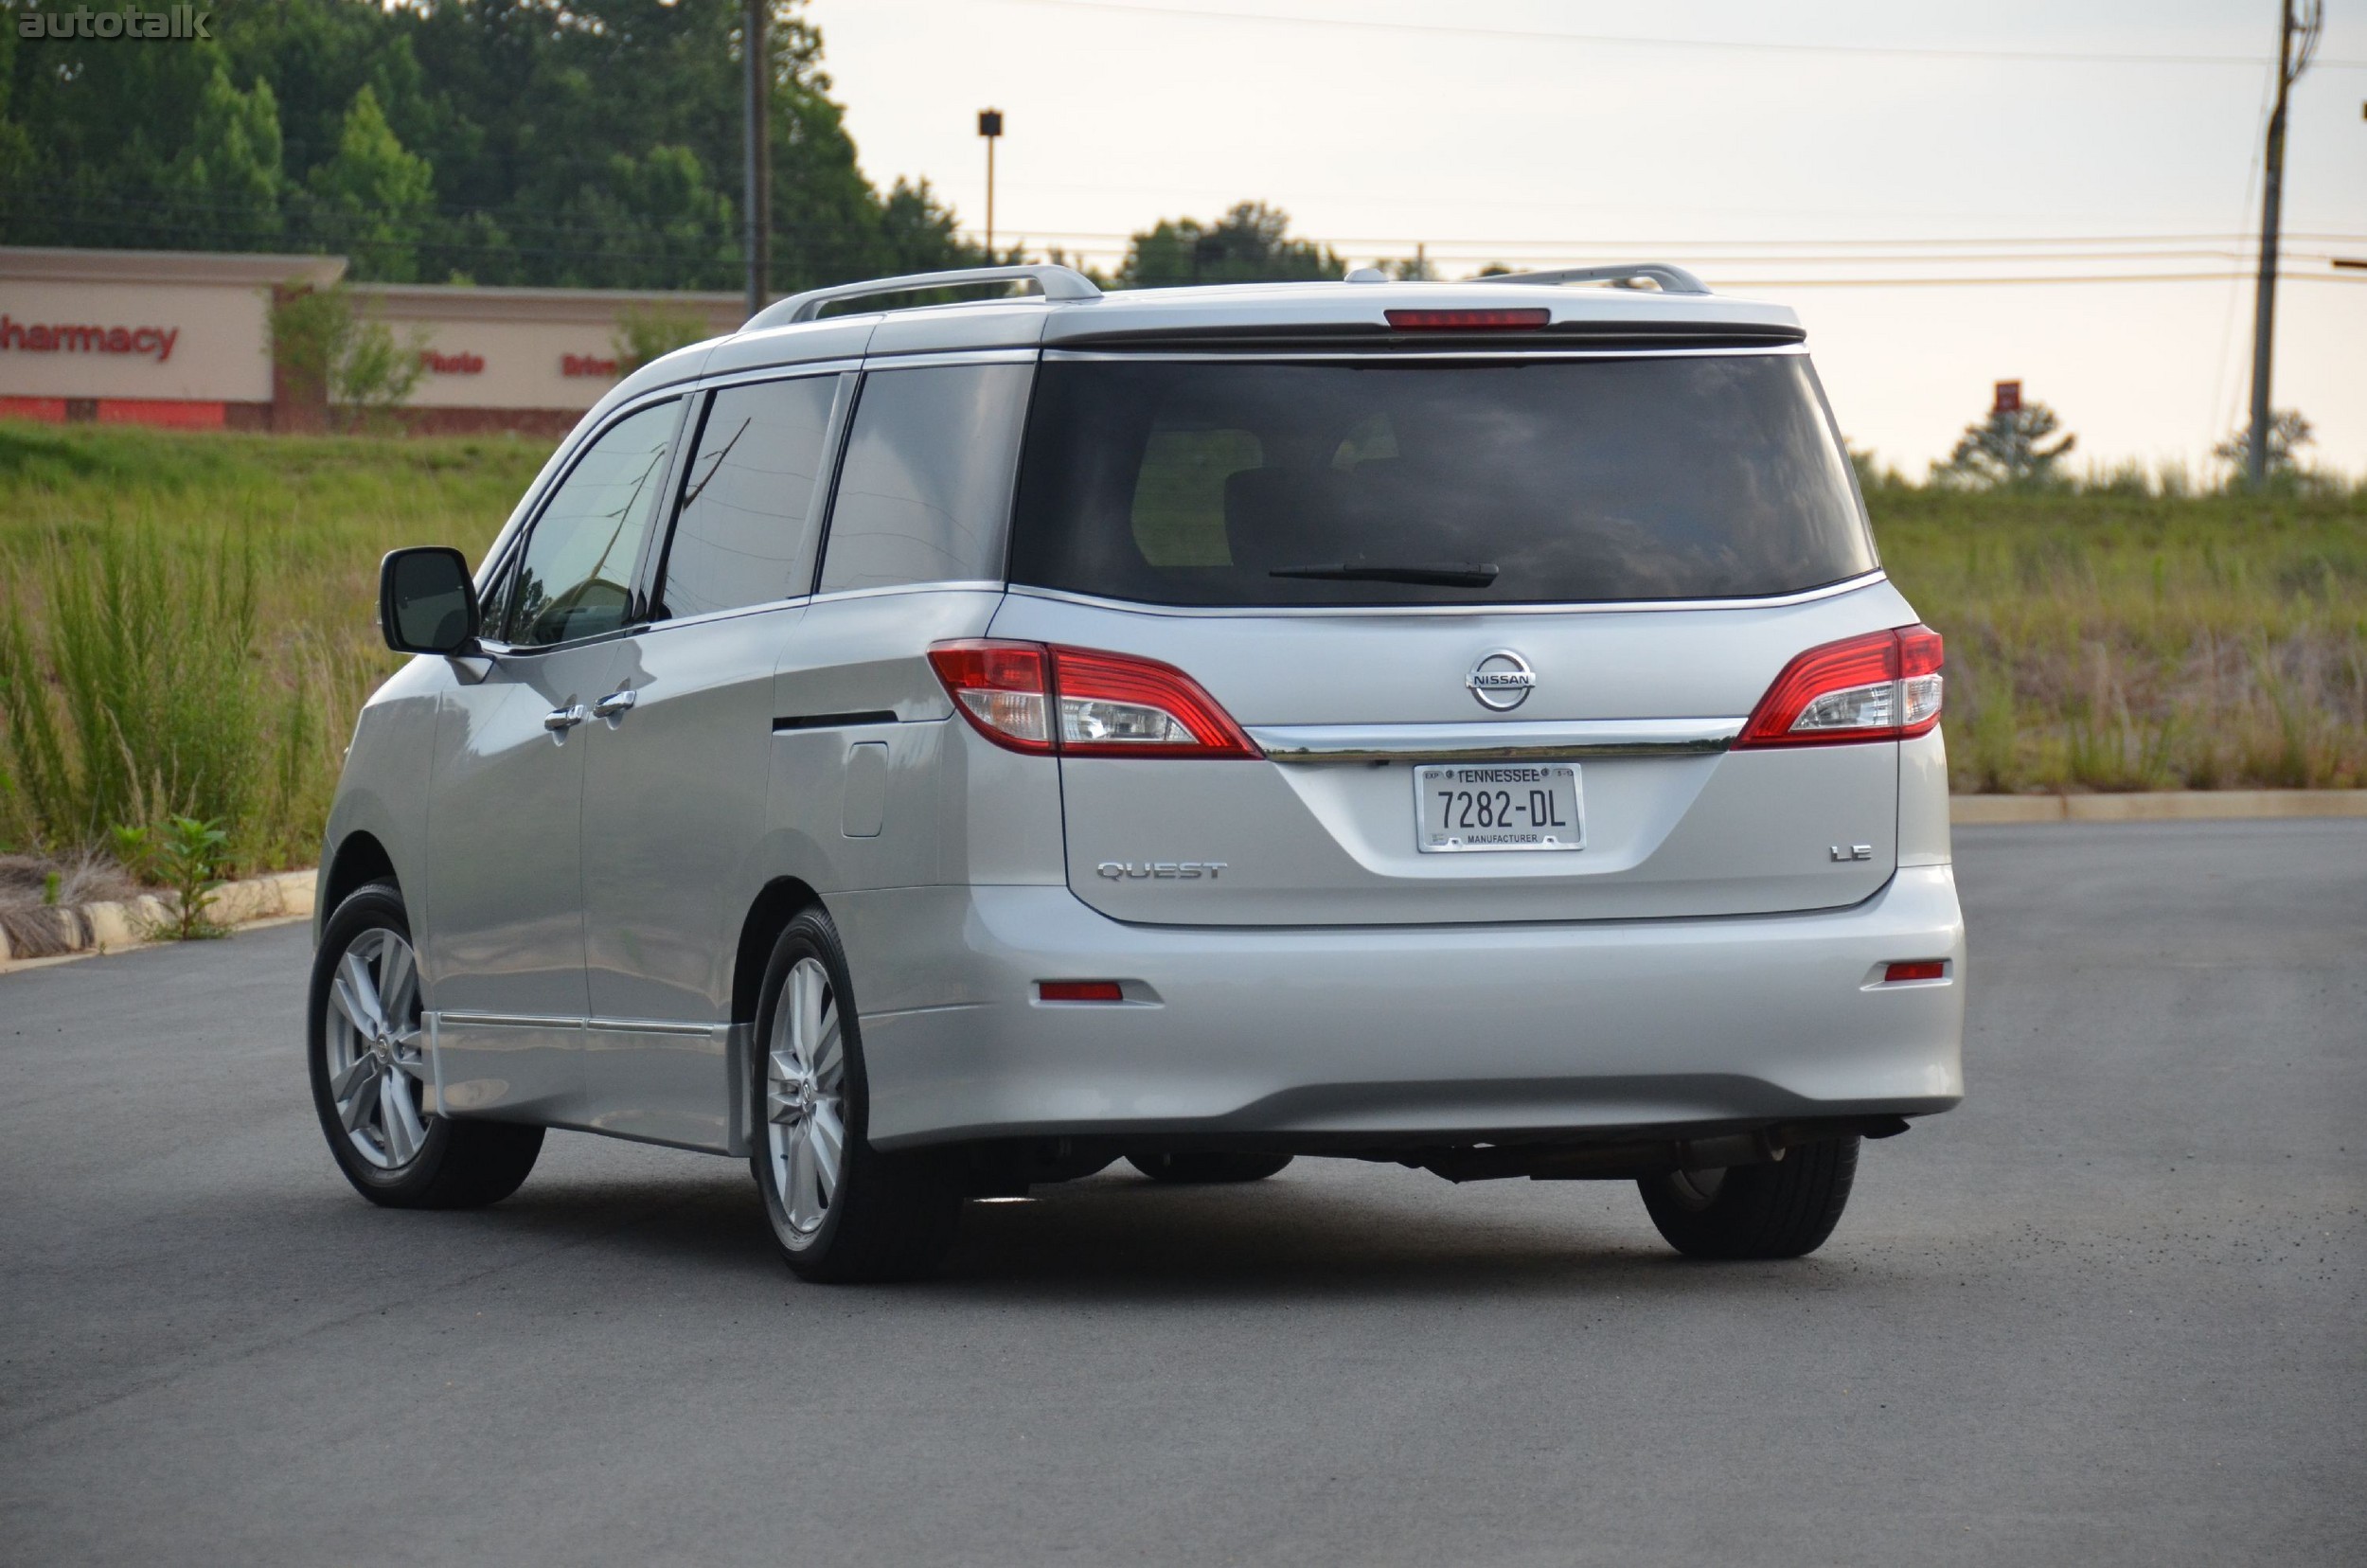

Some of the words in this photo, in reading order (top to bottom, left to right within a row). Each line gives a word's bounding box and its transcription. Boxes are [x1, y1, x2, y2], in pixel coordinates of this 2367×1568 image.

[0, 313, 180, 364] harmacy
[1473, 675, 1529, 686] NISSAN
[1458, 769, 1540, 783] TENNESSEE
[1437, 790, 1566, 829] 7282-DL
[1468, 834, 1538, 844] MANUFACTURER
[1829, 845, 1872, 863] LE
[1096, 862, 1228, 882] QUEST
